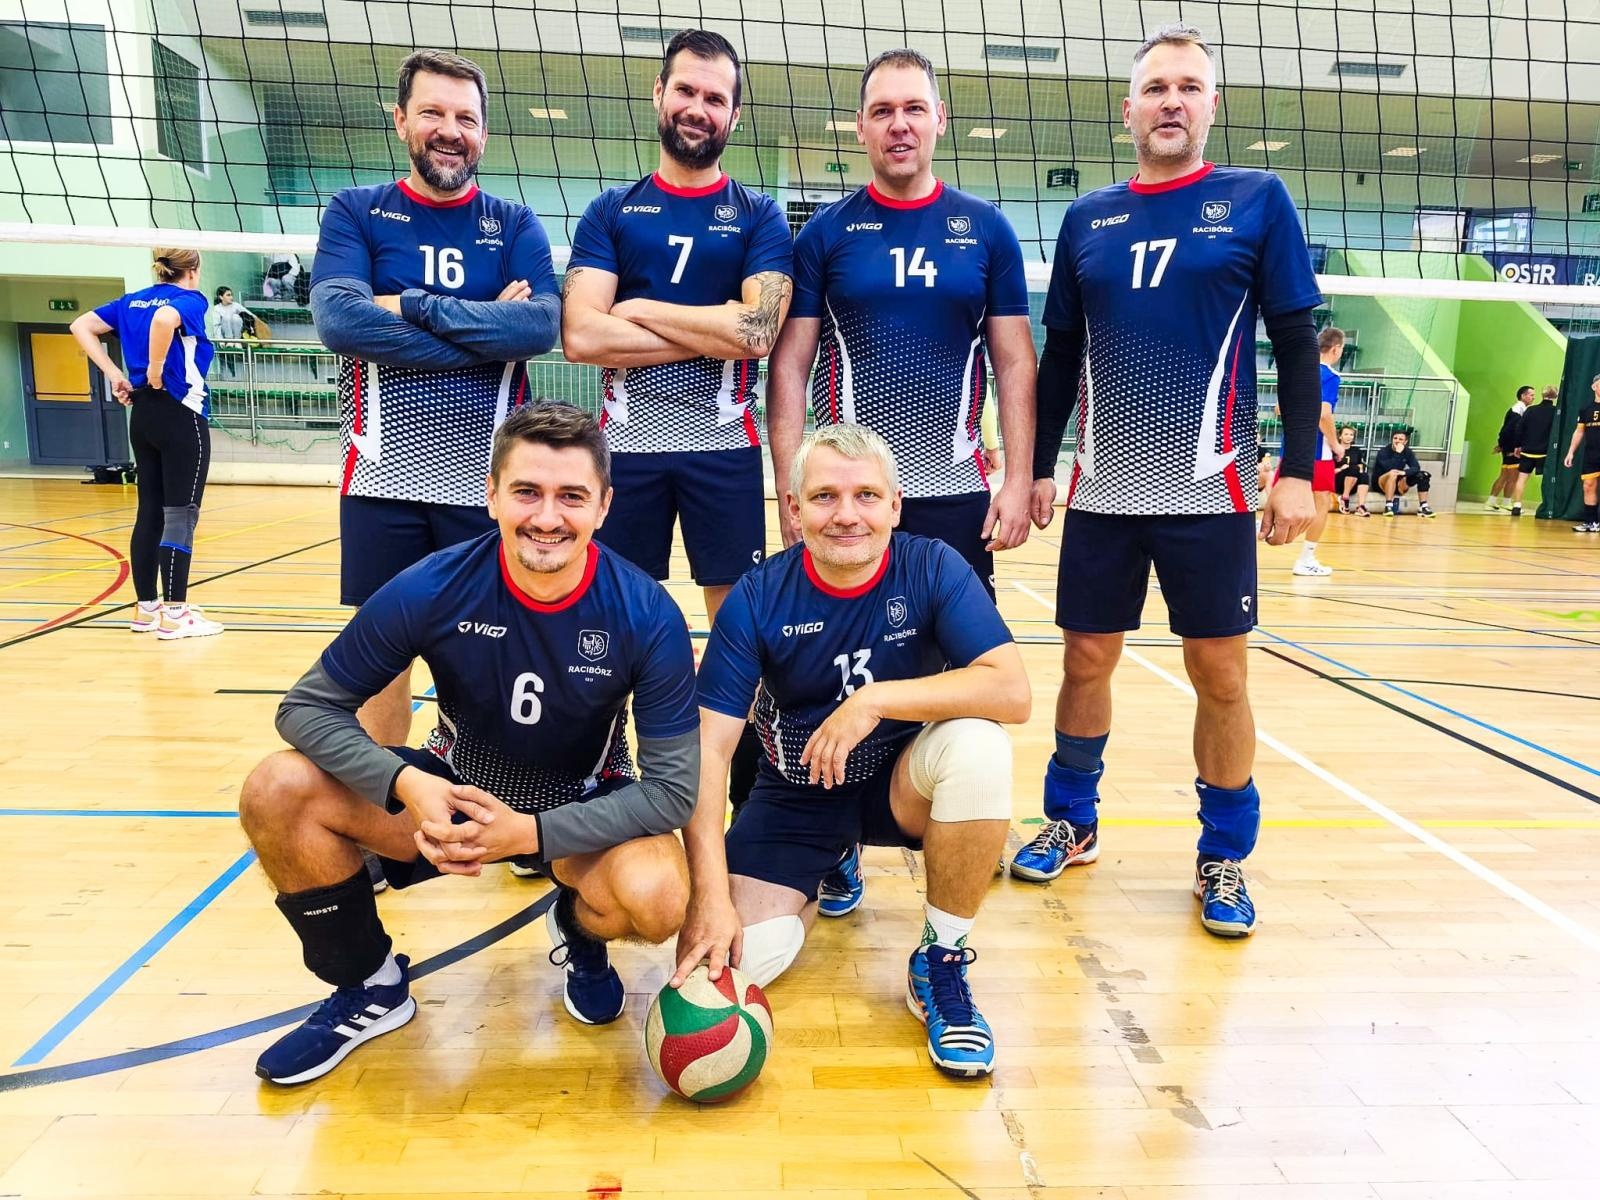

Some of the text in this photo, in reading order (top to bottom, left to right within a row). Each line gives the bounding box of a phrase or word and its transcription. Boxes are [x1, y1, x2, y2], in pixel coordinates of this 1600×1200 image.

[419, 245, 465, 289] 16
[668, 235, 694, 284] 7
[889, 247, 938, 288] 14
[1129, 238, 1177, 289] 17
[568, 665, 612, 677] RACIBÓRZ
[510, 672, 545, 725] 6
